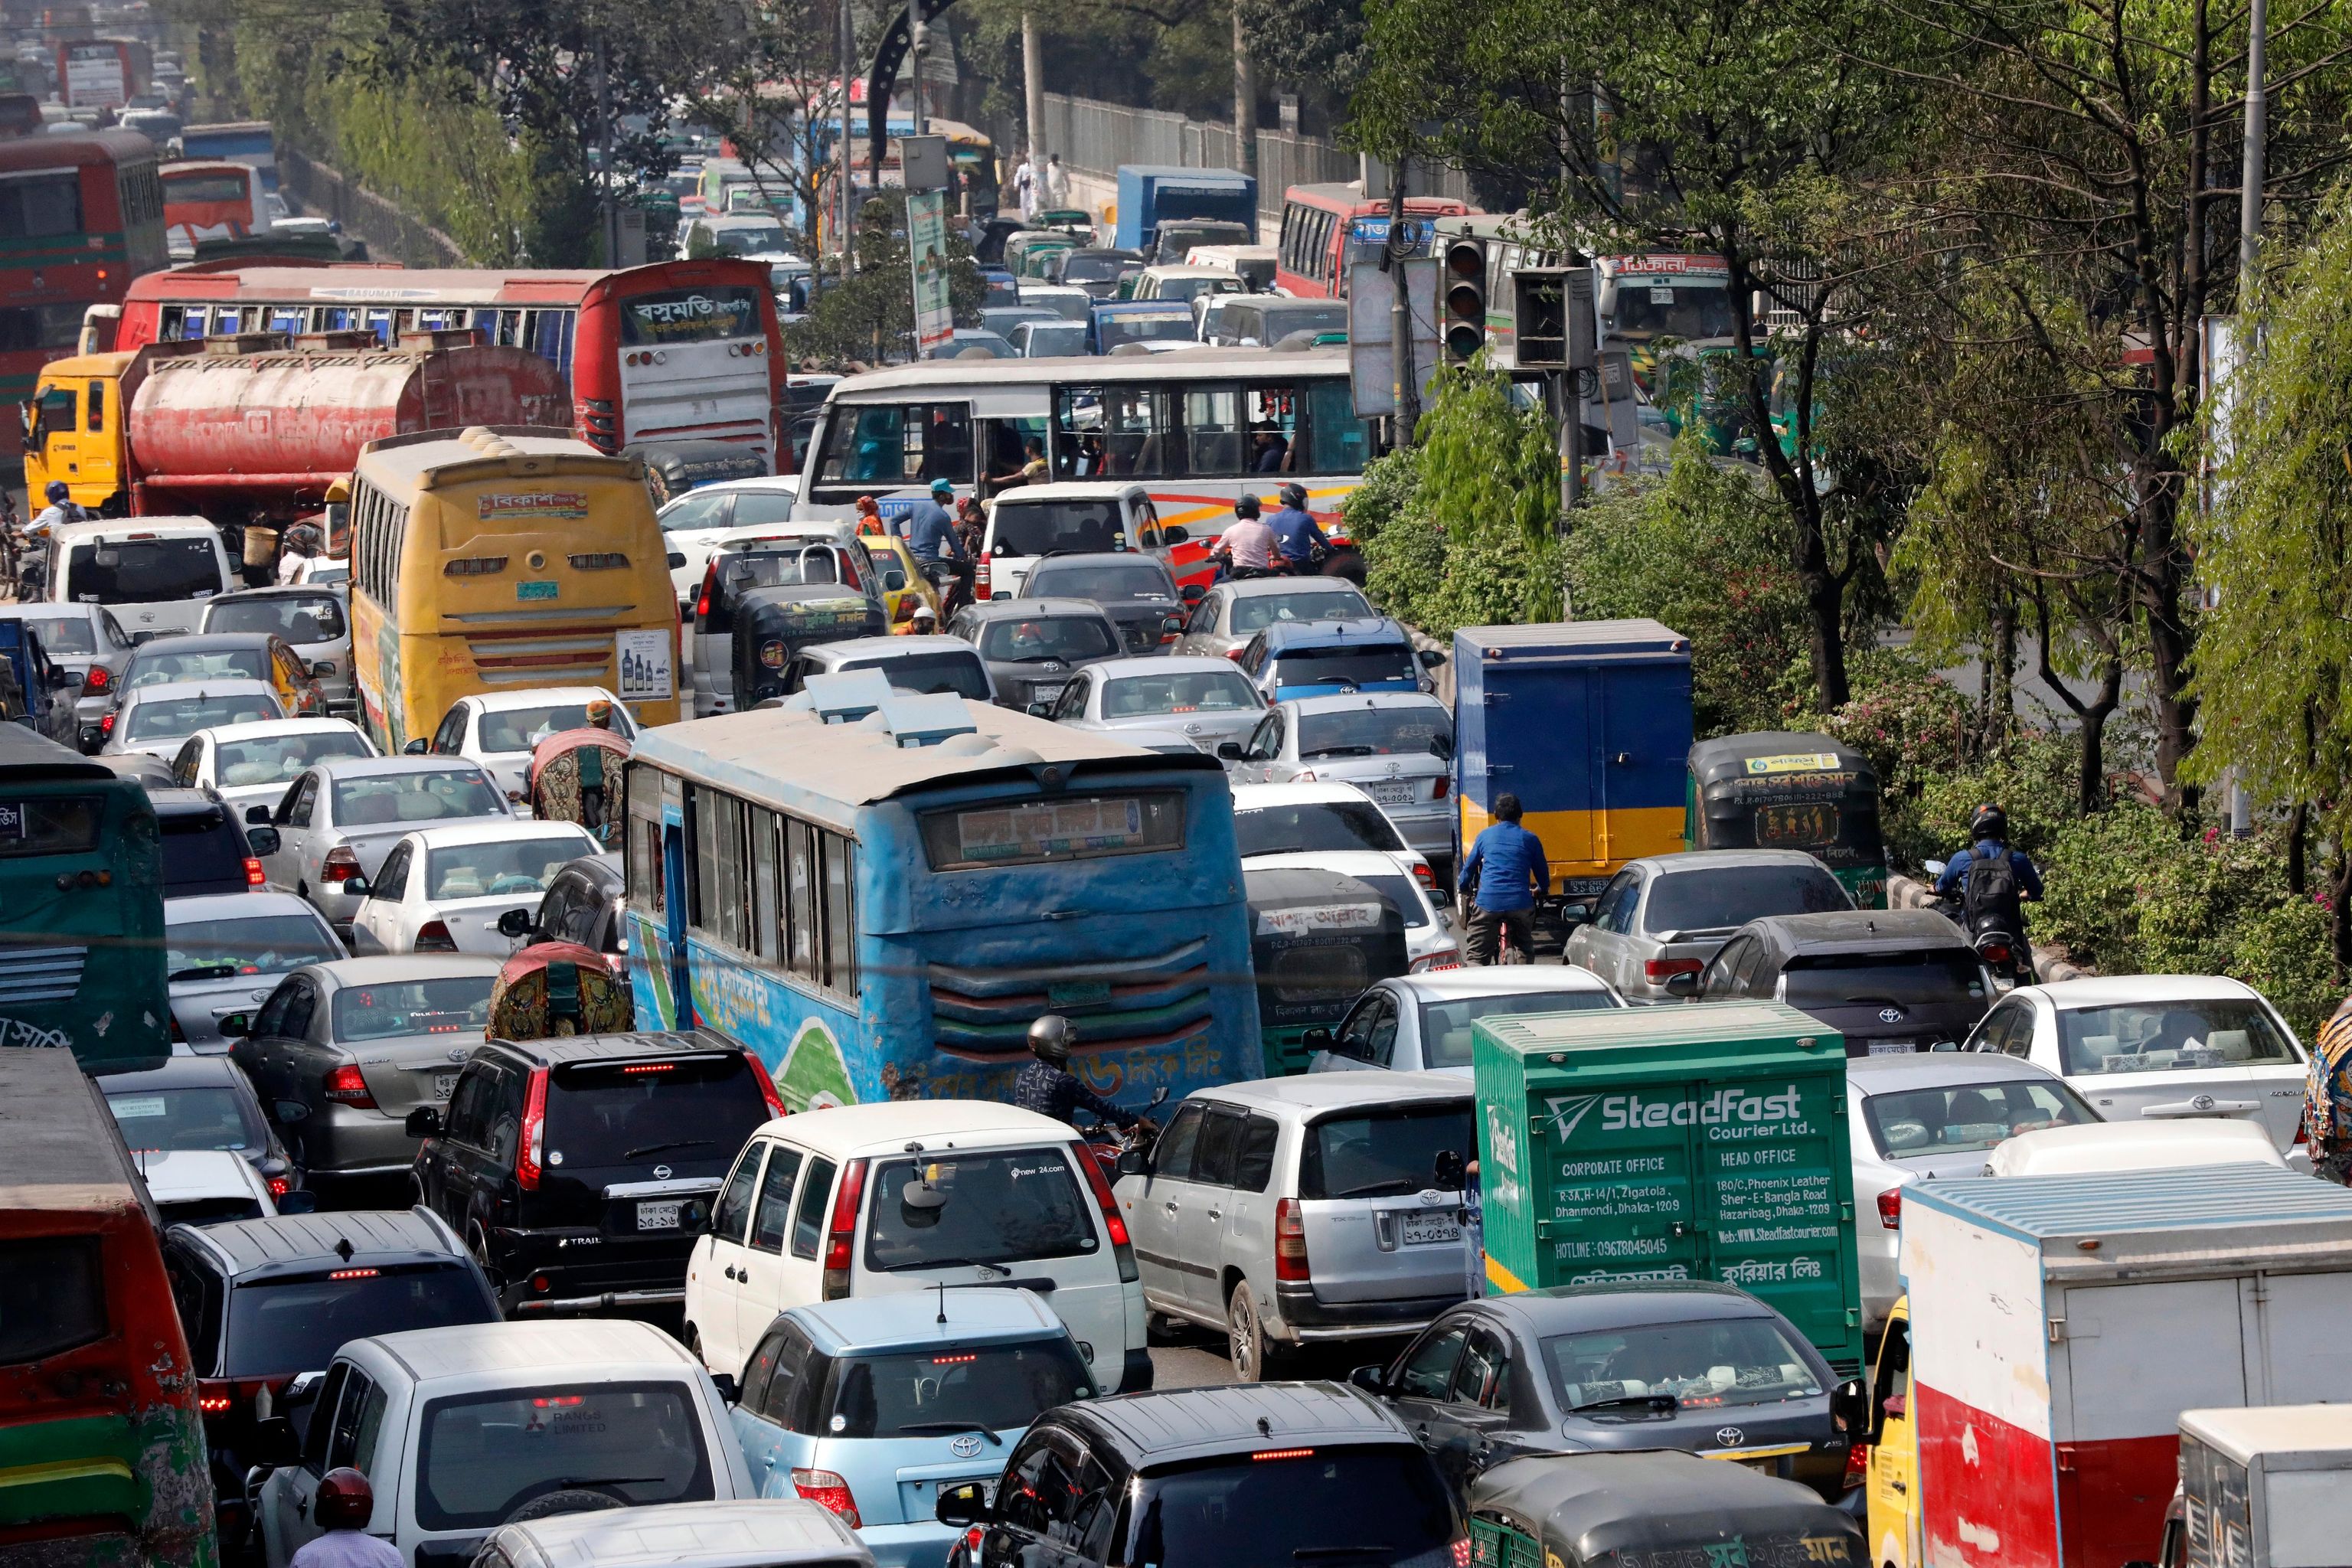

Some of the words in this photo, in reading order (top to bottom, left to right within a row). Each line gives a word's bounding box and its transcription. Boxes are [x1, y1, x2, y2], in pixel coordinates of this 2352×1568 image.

[346, 289, 400, 298] BASUMATI
[635, 295, 714, 322] বসুমতি
[494, 495, 554, 508] বিকাশ
[1887, 1044, 1907, 1054] মেট্রো
[1709, 1123, 1779, 1140] Courier
[1782, 1121, 1816, 1135] Ltd.
[1721, 1152, 1750, 1167] HEAD
[1754, 1148, 1796, 1164] OFFICE
[1038, 1165, 1065, 1174] 24.com
[1562, 1160, 1622, 1177] CORPORATE
[1626, 1157, 1664, 1173] OFFICE
[1792, 1175, 1830, 1187] Leather
[1803, 1188, 1827, 1200] Road
[640, 1206, 657, 1214] ঢাকা
[1720, 1259, 1786, 1286] কুরিয়ার
[1791, 1256, 1821, 1278] লিঃ
[554, 1411, 601, 1422] RANGS
[554, 1423, 606, 1435] LIMITED
